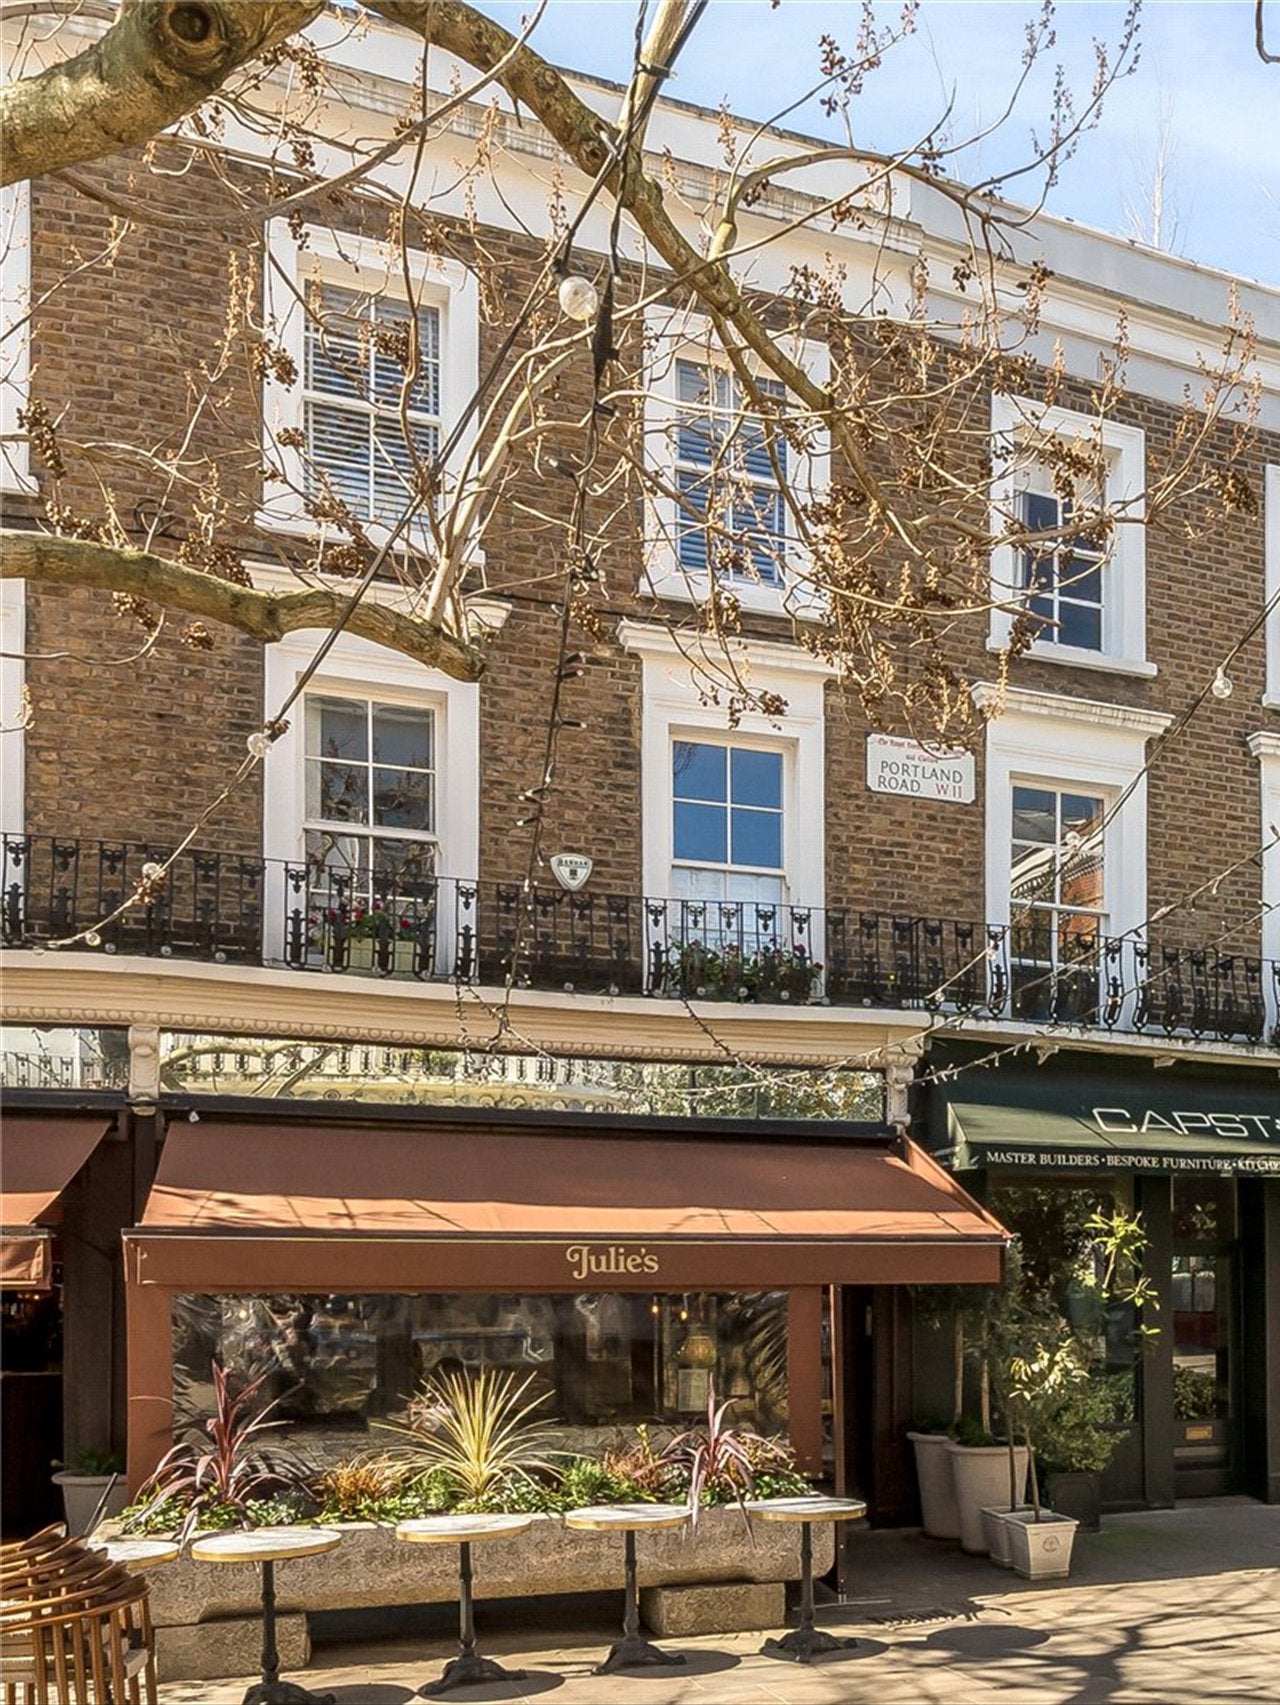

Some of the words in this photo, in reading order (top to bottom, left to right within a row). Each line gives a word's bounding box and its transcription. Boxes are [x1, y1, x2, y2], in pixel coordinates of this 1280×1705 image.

[880, 760, 963, 784] PORTLAND
[877, 775, 920, 793] ROAD
[986, 1151, 1036, 1165] MASTER
[1040, 1153, 1100, 1166] BUILDERS
[1106, 1155, 1160, 1168] BESPOKE
[1162, 1157, 1232, 1170] FURNITURE
[566, 1245, 659, 1279] Julie's
